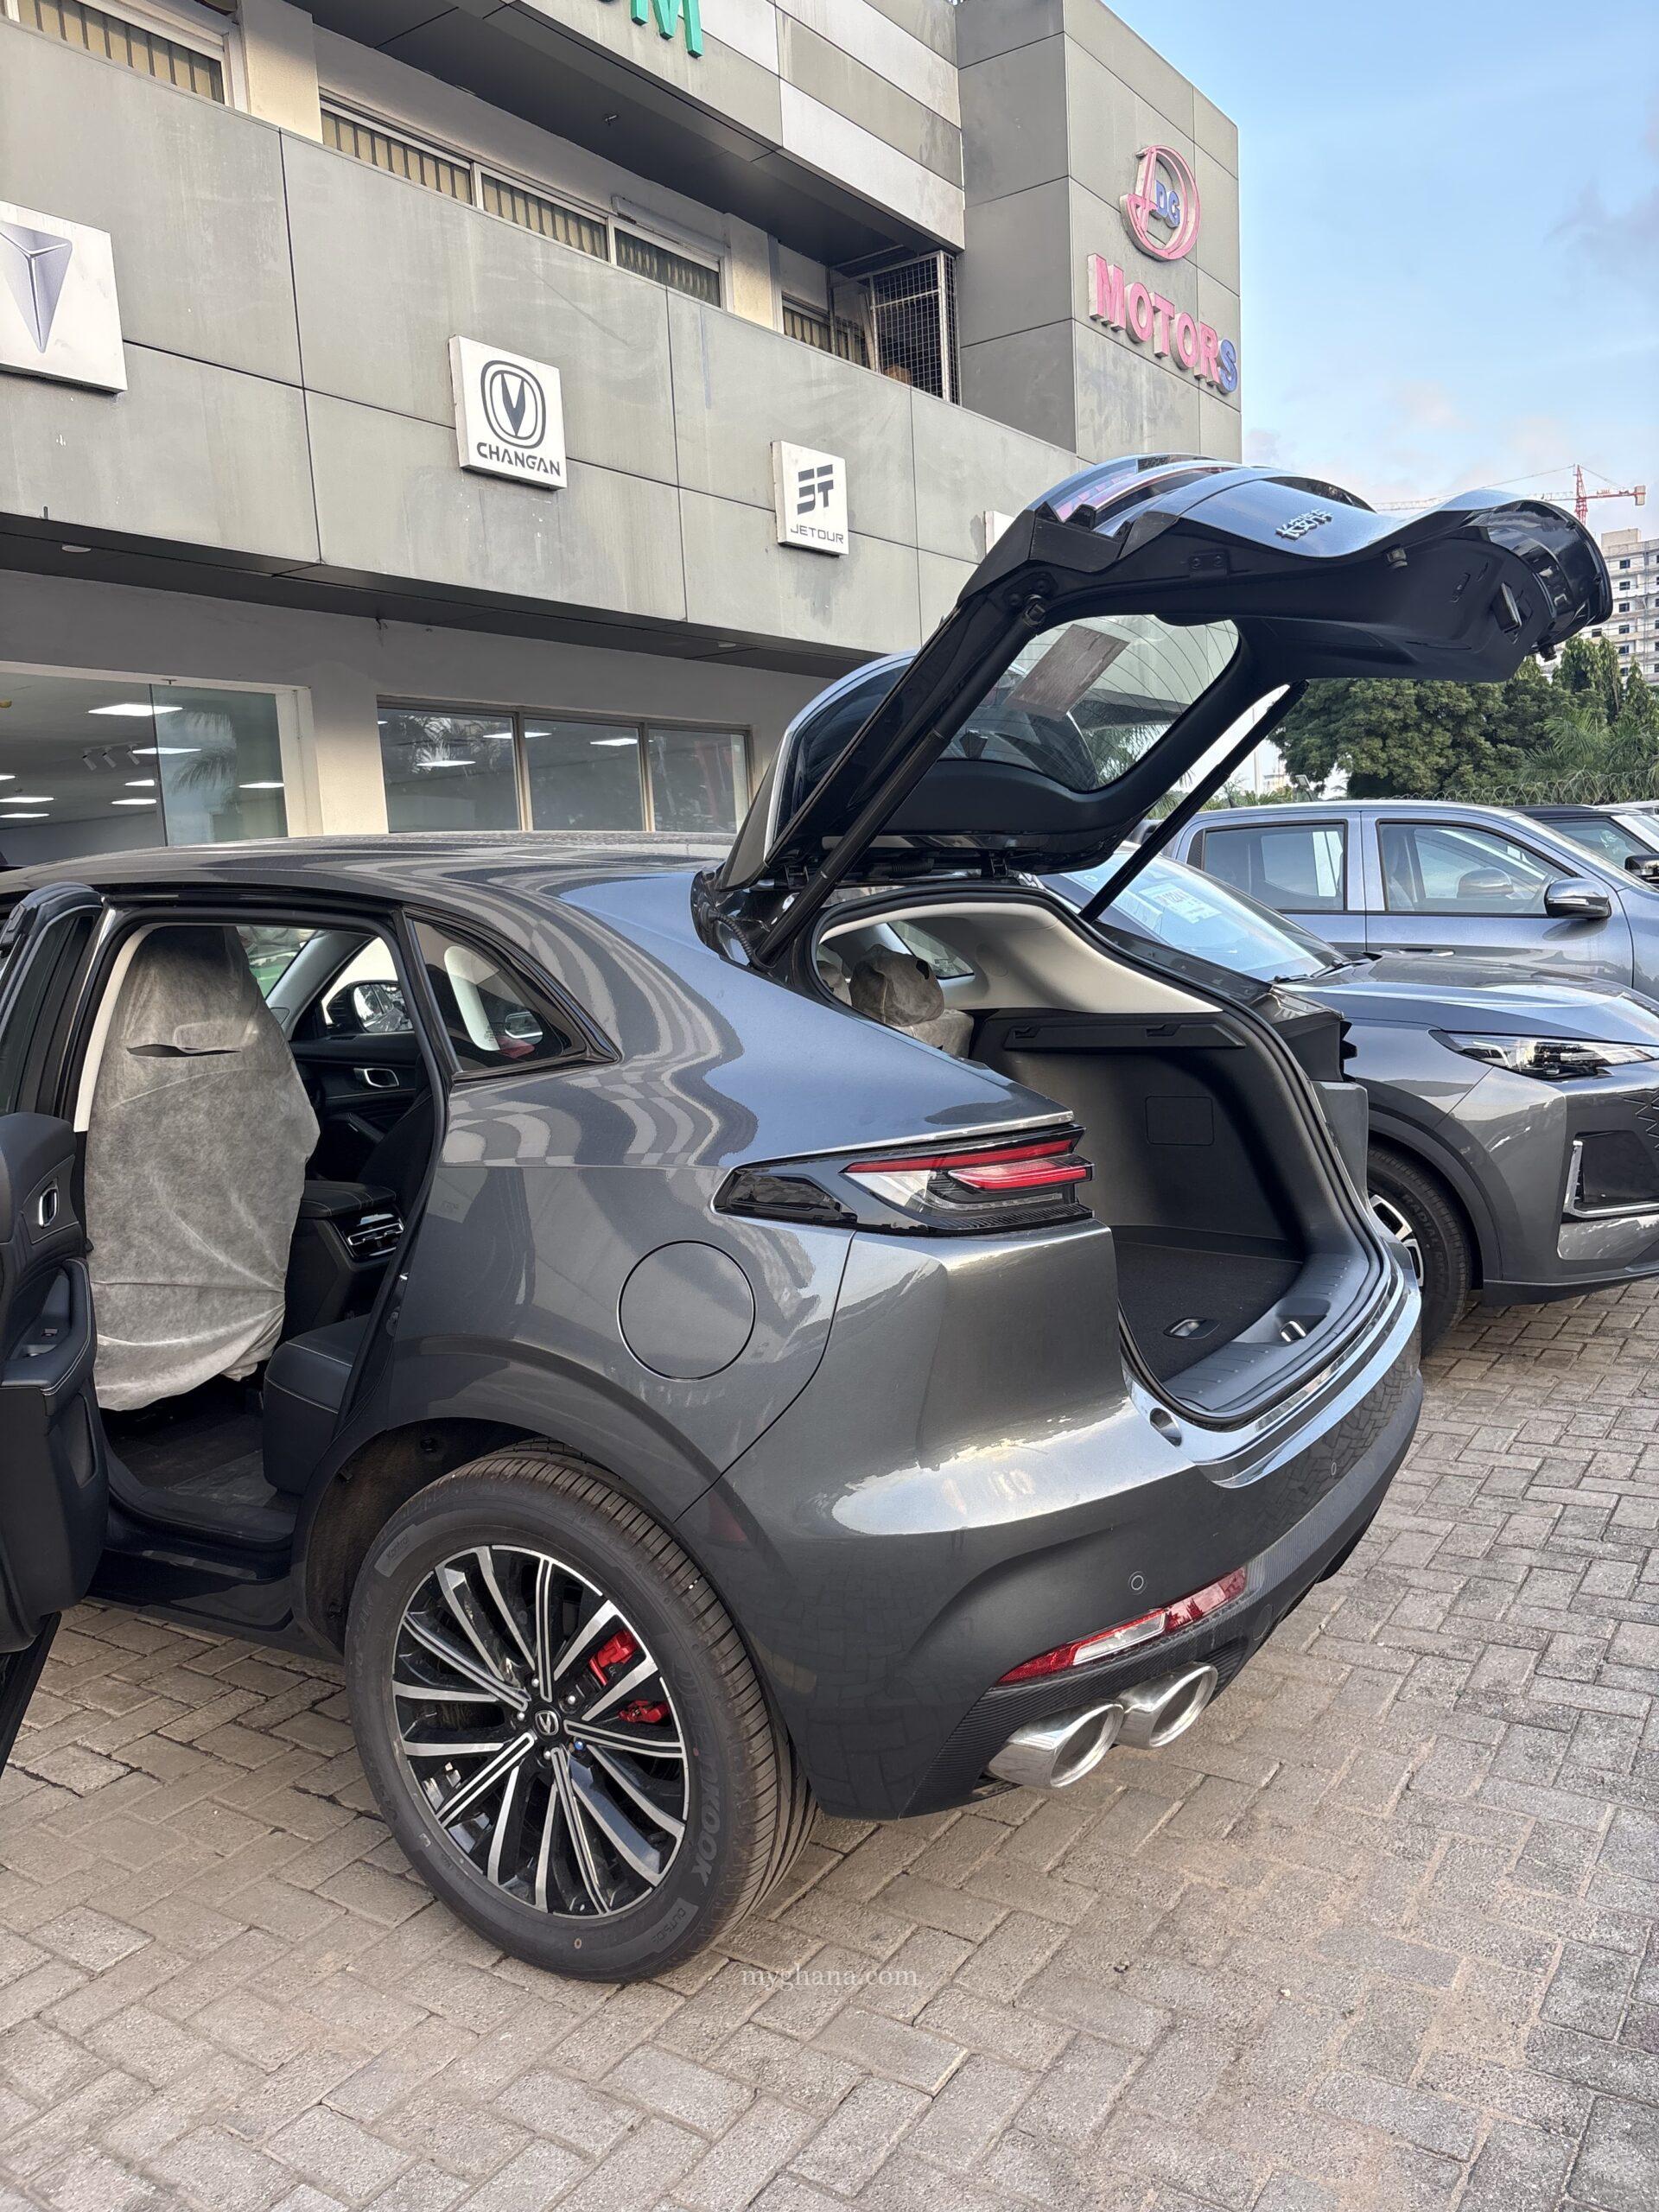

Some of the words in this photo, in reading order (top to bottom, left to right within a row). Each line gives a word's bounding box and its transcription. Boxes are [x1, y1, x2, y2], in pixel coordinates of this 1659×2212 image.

[1088, 253, 1238, 394] MOTORS
[476, 442, 561, 476] CHANGAN
[790, 524, 844, 543] JETOUR
